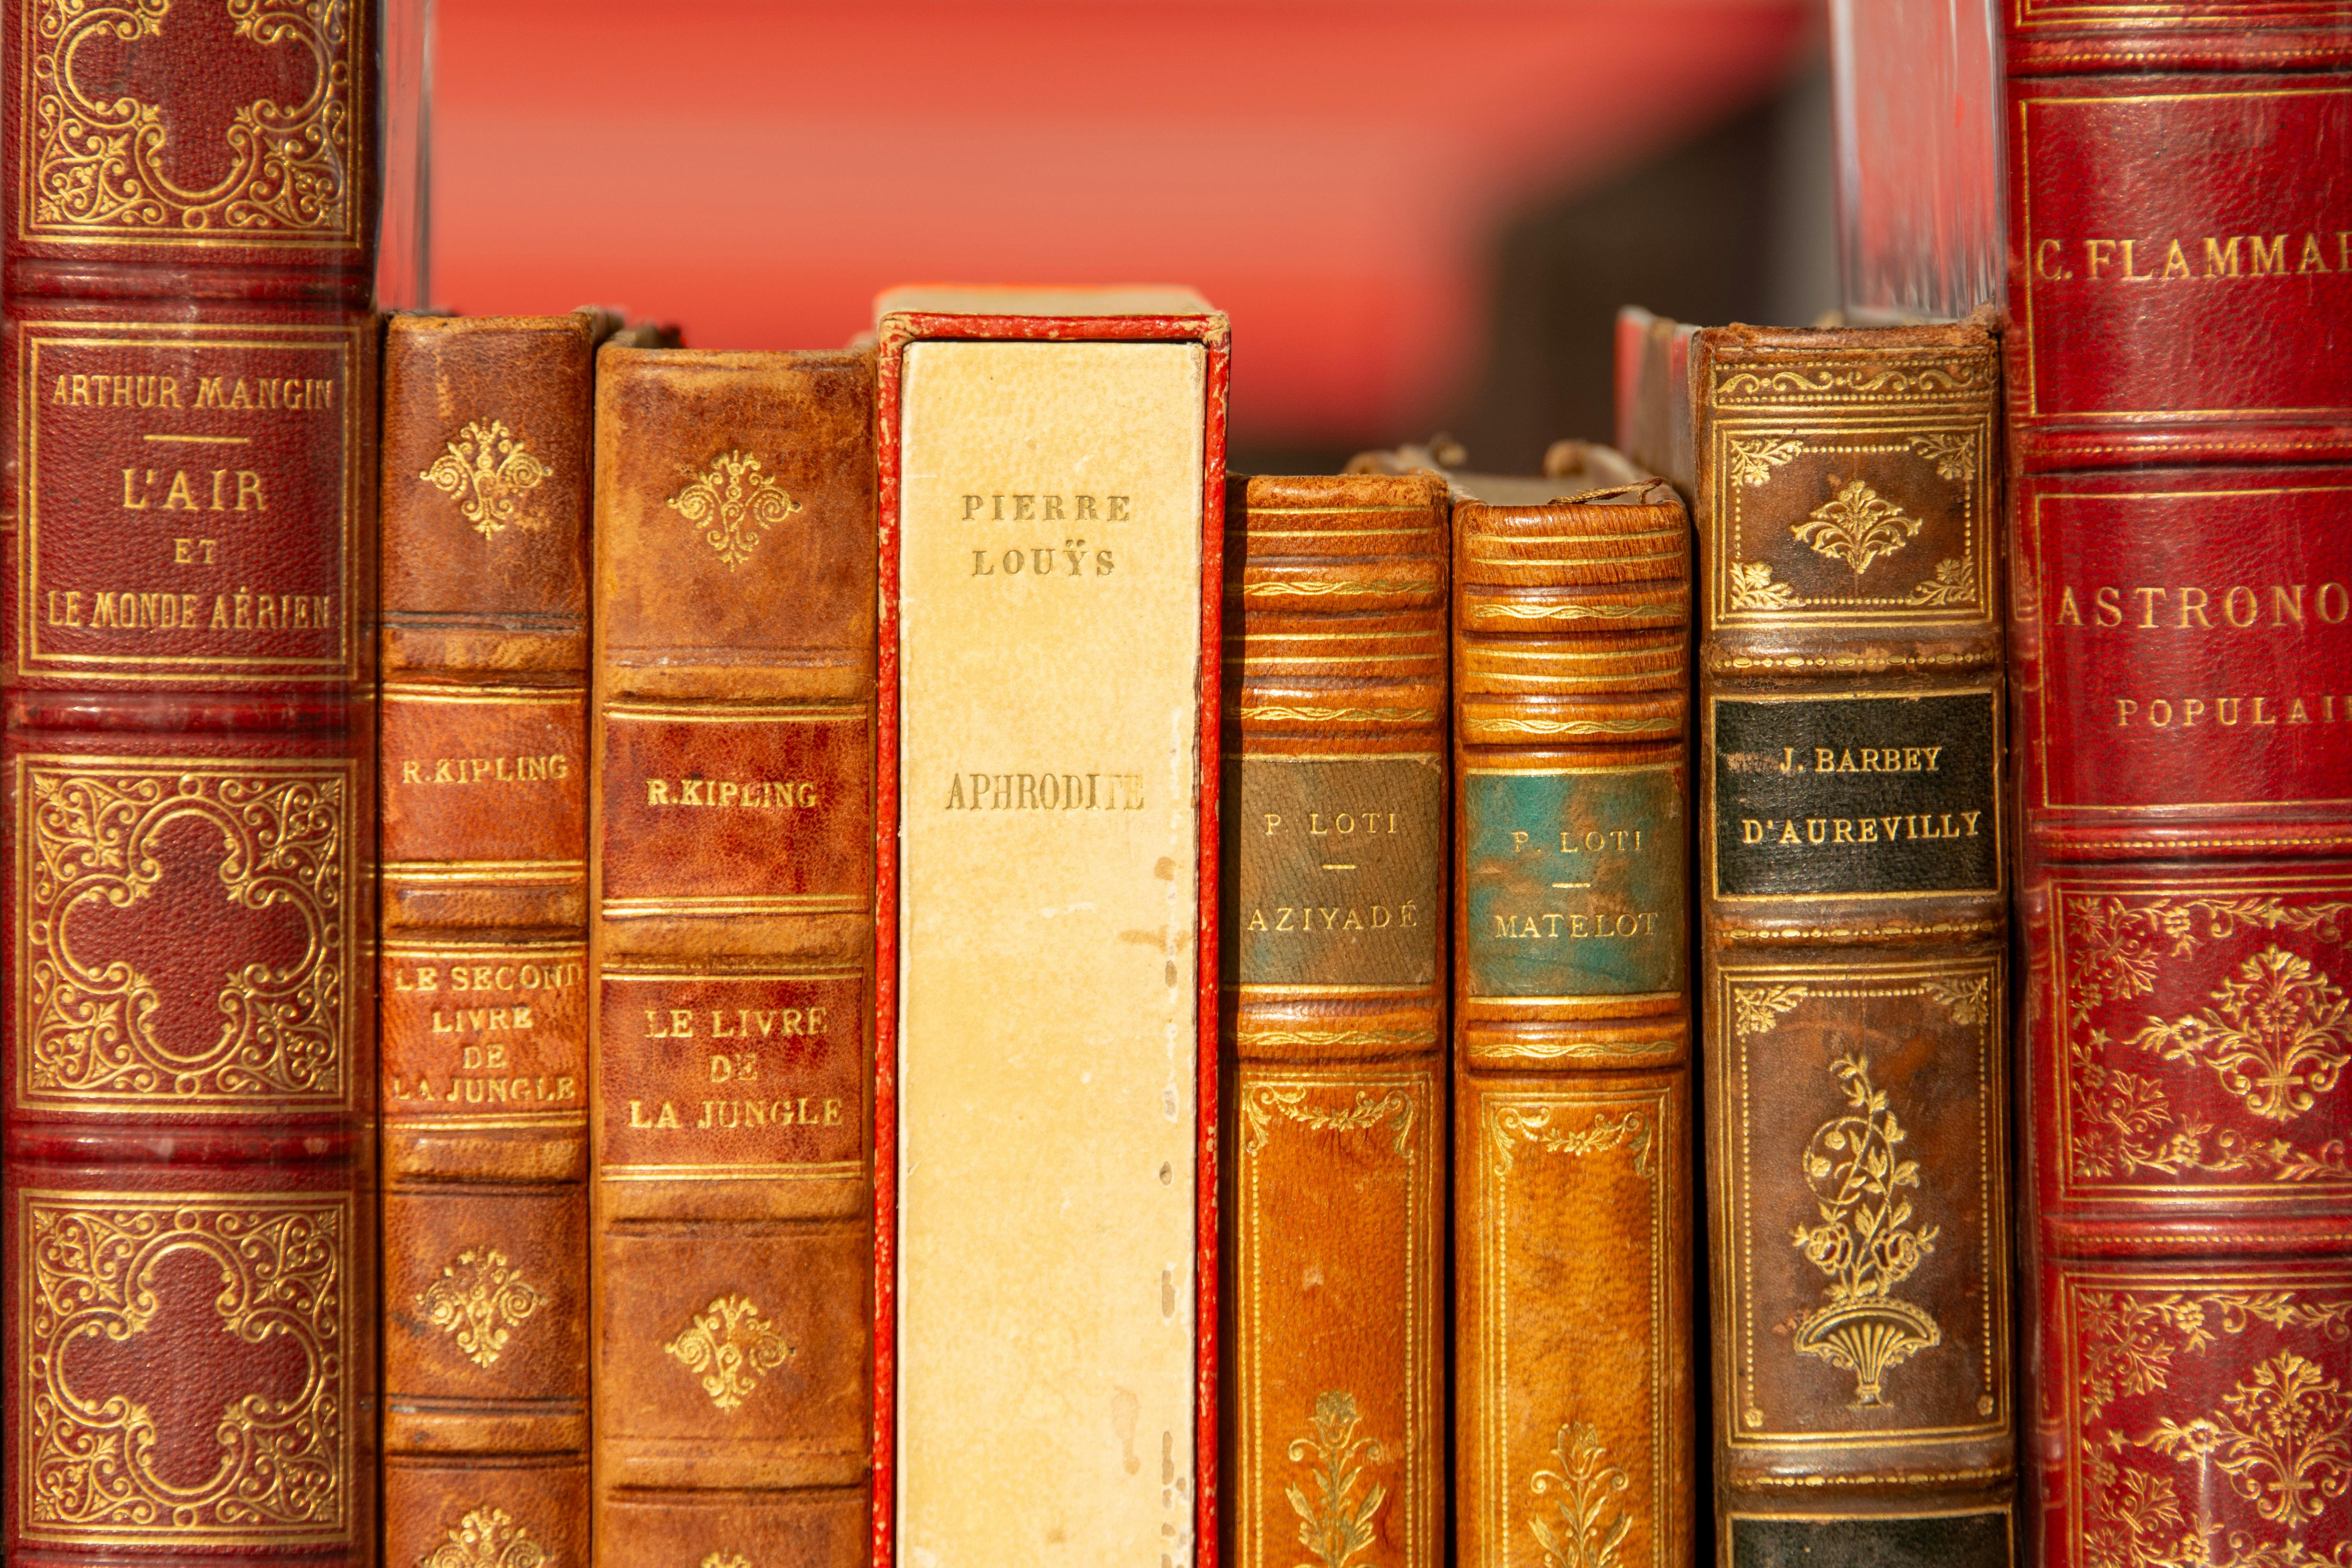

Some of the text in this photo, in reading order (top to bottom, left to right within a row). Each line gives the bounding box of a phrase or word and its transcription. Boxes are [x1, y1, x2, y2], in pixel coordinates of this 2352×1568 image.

[2038, 239, 2073, 281] C.
[53, 375, 332, 410] ARTHUR MANGIN
[122, 469, 267, 511] L'AIR
[962, 495, 1130, 522] PIERRE
[174, 539, 217, 564] ET
[973, 539, 1116, 577] LOUŸS
[48, 586, 330, 628] LE MONDE AÉRIEN
[2055, 582, 2349, 628] ASTRONO
[1779, 746, 1942, 772] J. BARBEY
[946, 773, 1144, 811] APHRODITE
[1309, 813, 1396, 834] LOTI
[1742, 811, 1981, 844] D'AUREVILLY
[1511, 830, 1642, 853] P. LOTI
[1247, 900, 1417, 931] AZIYADÉ
[1495, 912, 1658, 938] MATELOT
[395, 963, 582, 991] LE SECOND
[432, 1007, 534, 1033] LIVRE
[644, 1007, 828, 1038] LE LIVRE
[462, 1044, 507, 1069] DE
[709, 1053, 758, 1083] DE
[394, 1077, 575, 1103] LA JUNGLE
[628, 1098, 843, 1129] LA JUNGLE
